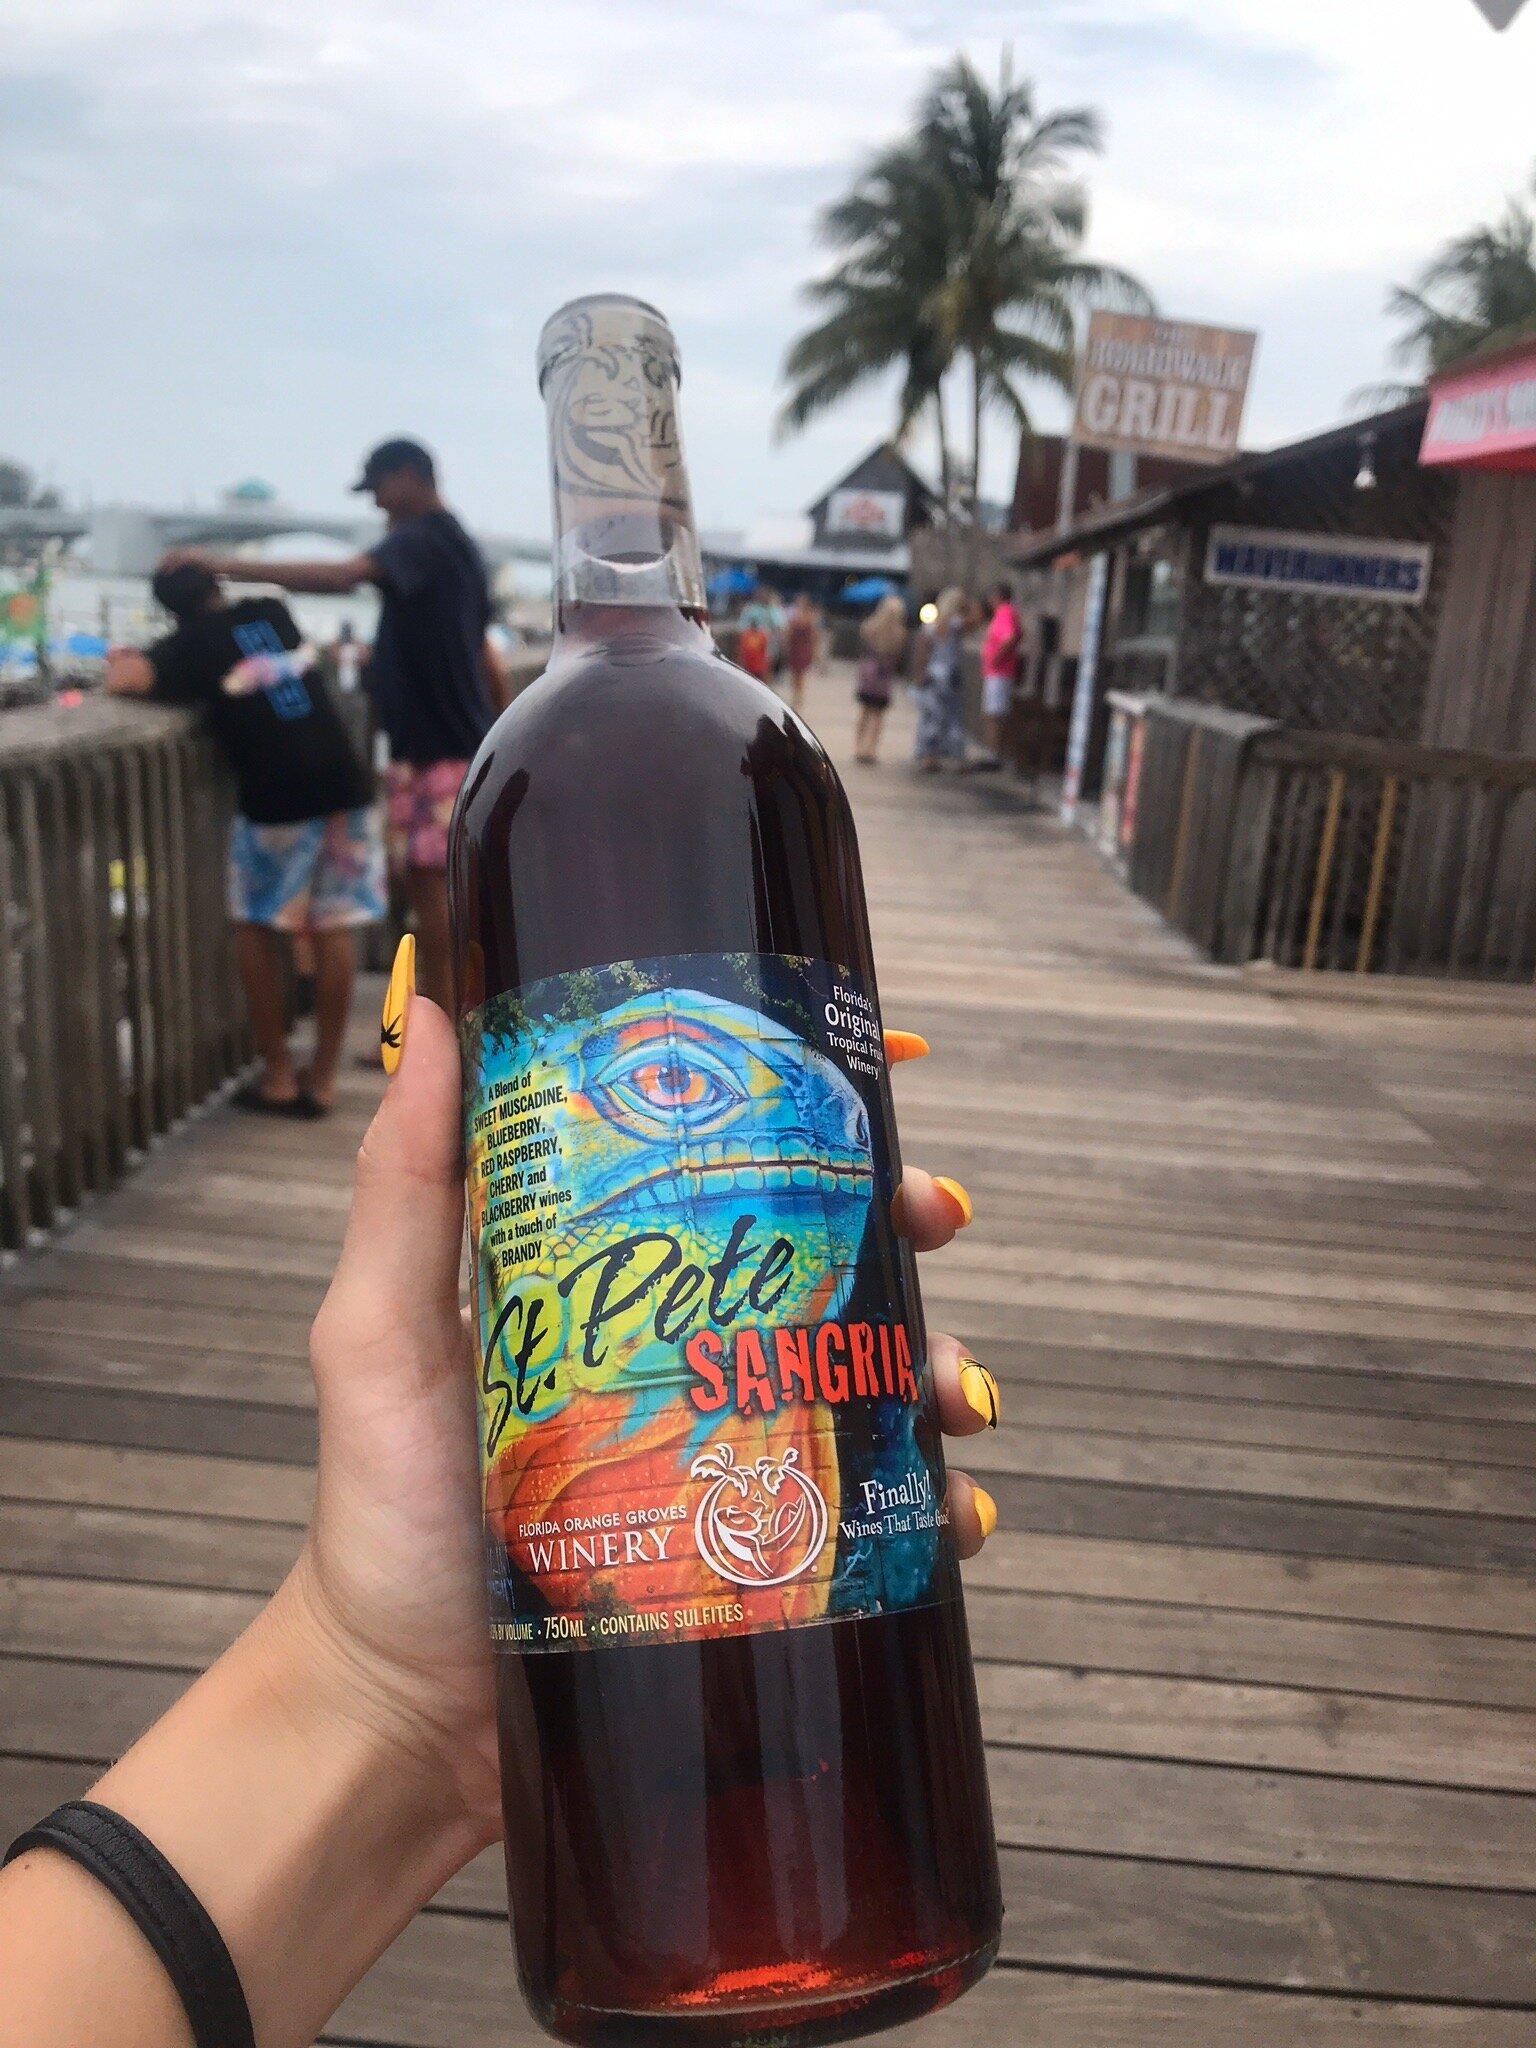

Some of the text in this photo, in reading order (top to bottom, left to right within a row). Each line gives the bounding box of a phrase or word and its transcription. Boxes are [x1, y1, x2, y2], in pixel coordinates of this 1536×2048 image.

[1083, 373, 1236, 449] GRILL
[833, 985, 873, 1013] Florida's
[824, 1002, 881, 1041] Original
[826, 1031, 868, 1054] Tropical
[487, 1071, 532, 1102] A Blend of
[474, 1085, 568, 1133] SWEET MUSCADINE,
[486, 1115, 546, 1151] BLUEBERRY,
[480, 1136, 563, 1179] RED RASPBERRY,
[489, 1166, 547, 1199] CHERRY and
[481, 1189, 572, 1228] BLACKBERRY wines
[490, 1212, 557, 1248] with a touch of
[501, 1239, 543, 1268] BRANDY
[482, 1214, 795, 1458] St. Pete
[685, 1321, 920, 1415] SANGRIA
[859, 1469, 932, 1515] Finally!
[518, 1505, 688, 1538] FLORIDA ORANGE GROVES
[839, 1519, 883, 1540] Wines
[883, 1514, 912, 1535] That
[911, 1511, 935, 1530] Taste
[527, 1525, 675, 1573] WINERY
[504, 1623, 534, 1641] VOLUME
[599, 1611, 670, 1636] CONTAINS
[673, 1602, 744, 1628] SULFITES
